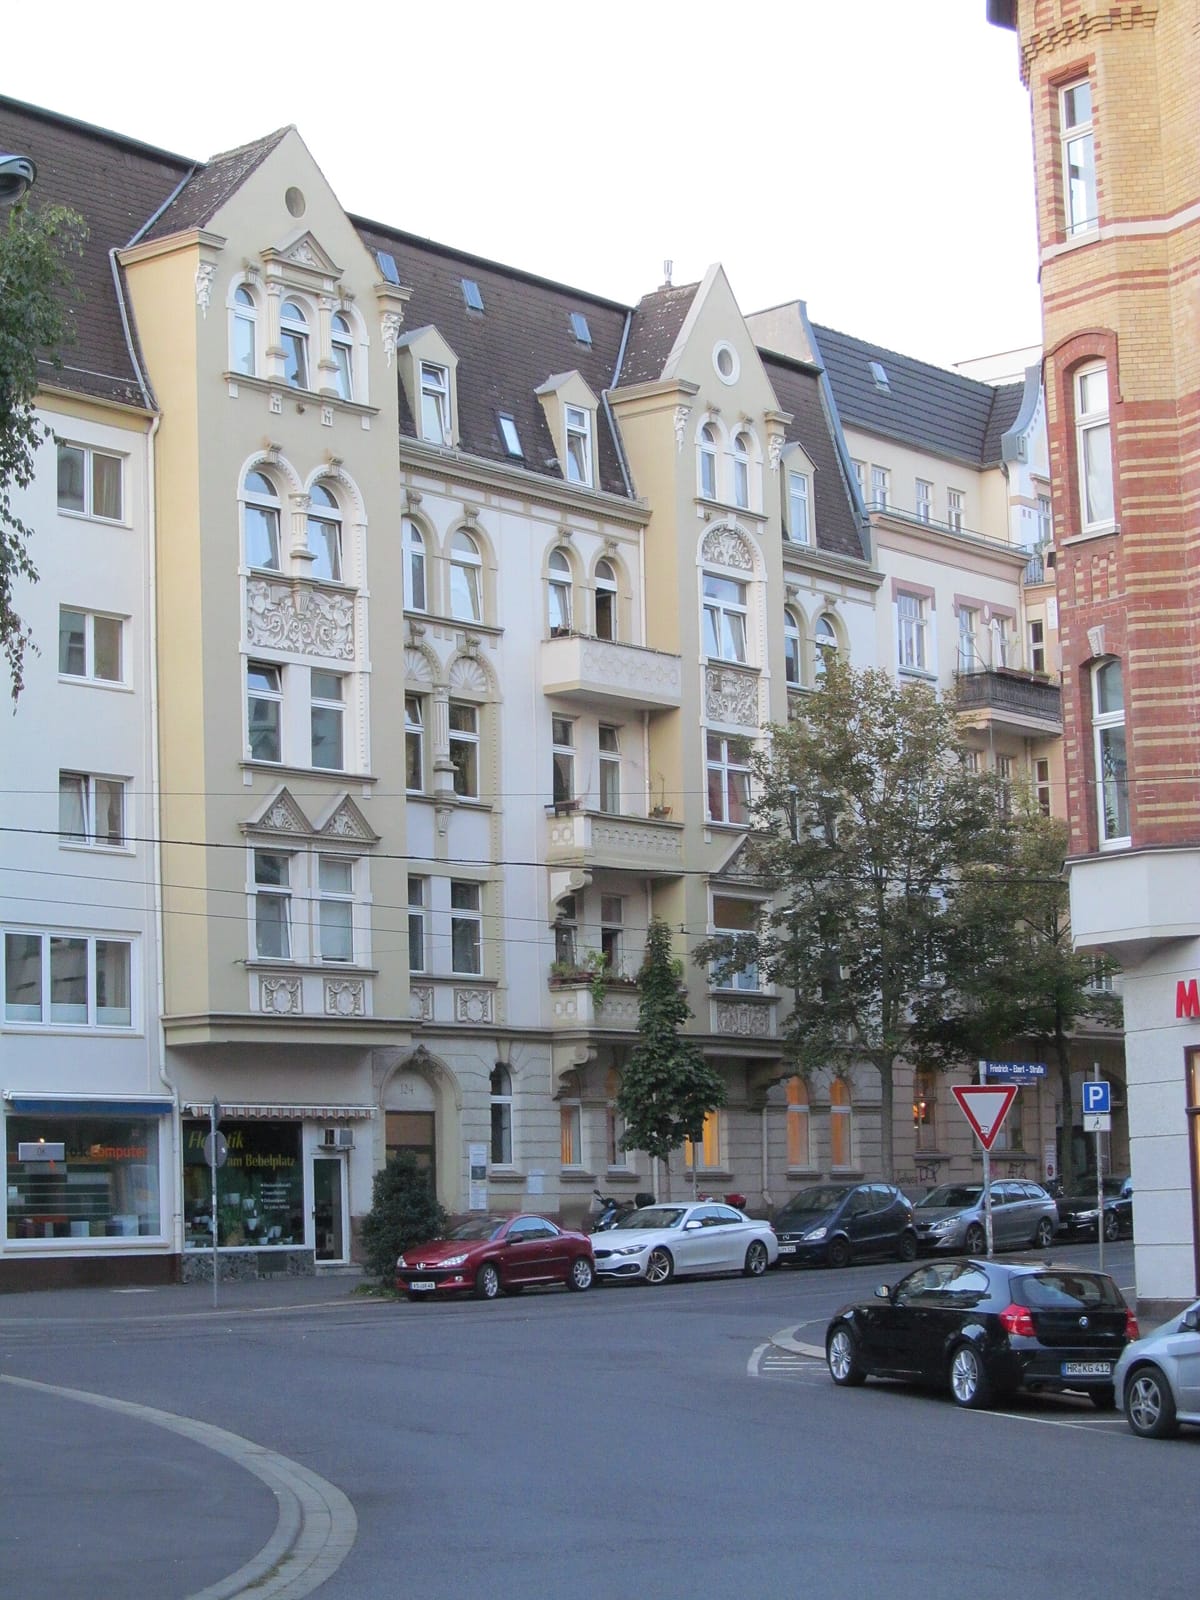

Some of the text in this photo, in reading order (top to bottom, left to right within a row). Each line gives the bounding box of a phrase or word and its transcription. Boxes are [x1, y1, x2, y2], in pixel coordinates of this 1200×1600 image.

[1089, 1086, 1103, 1109] P
[227, 1154, 295, 1171] am Bebelplatz
